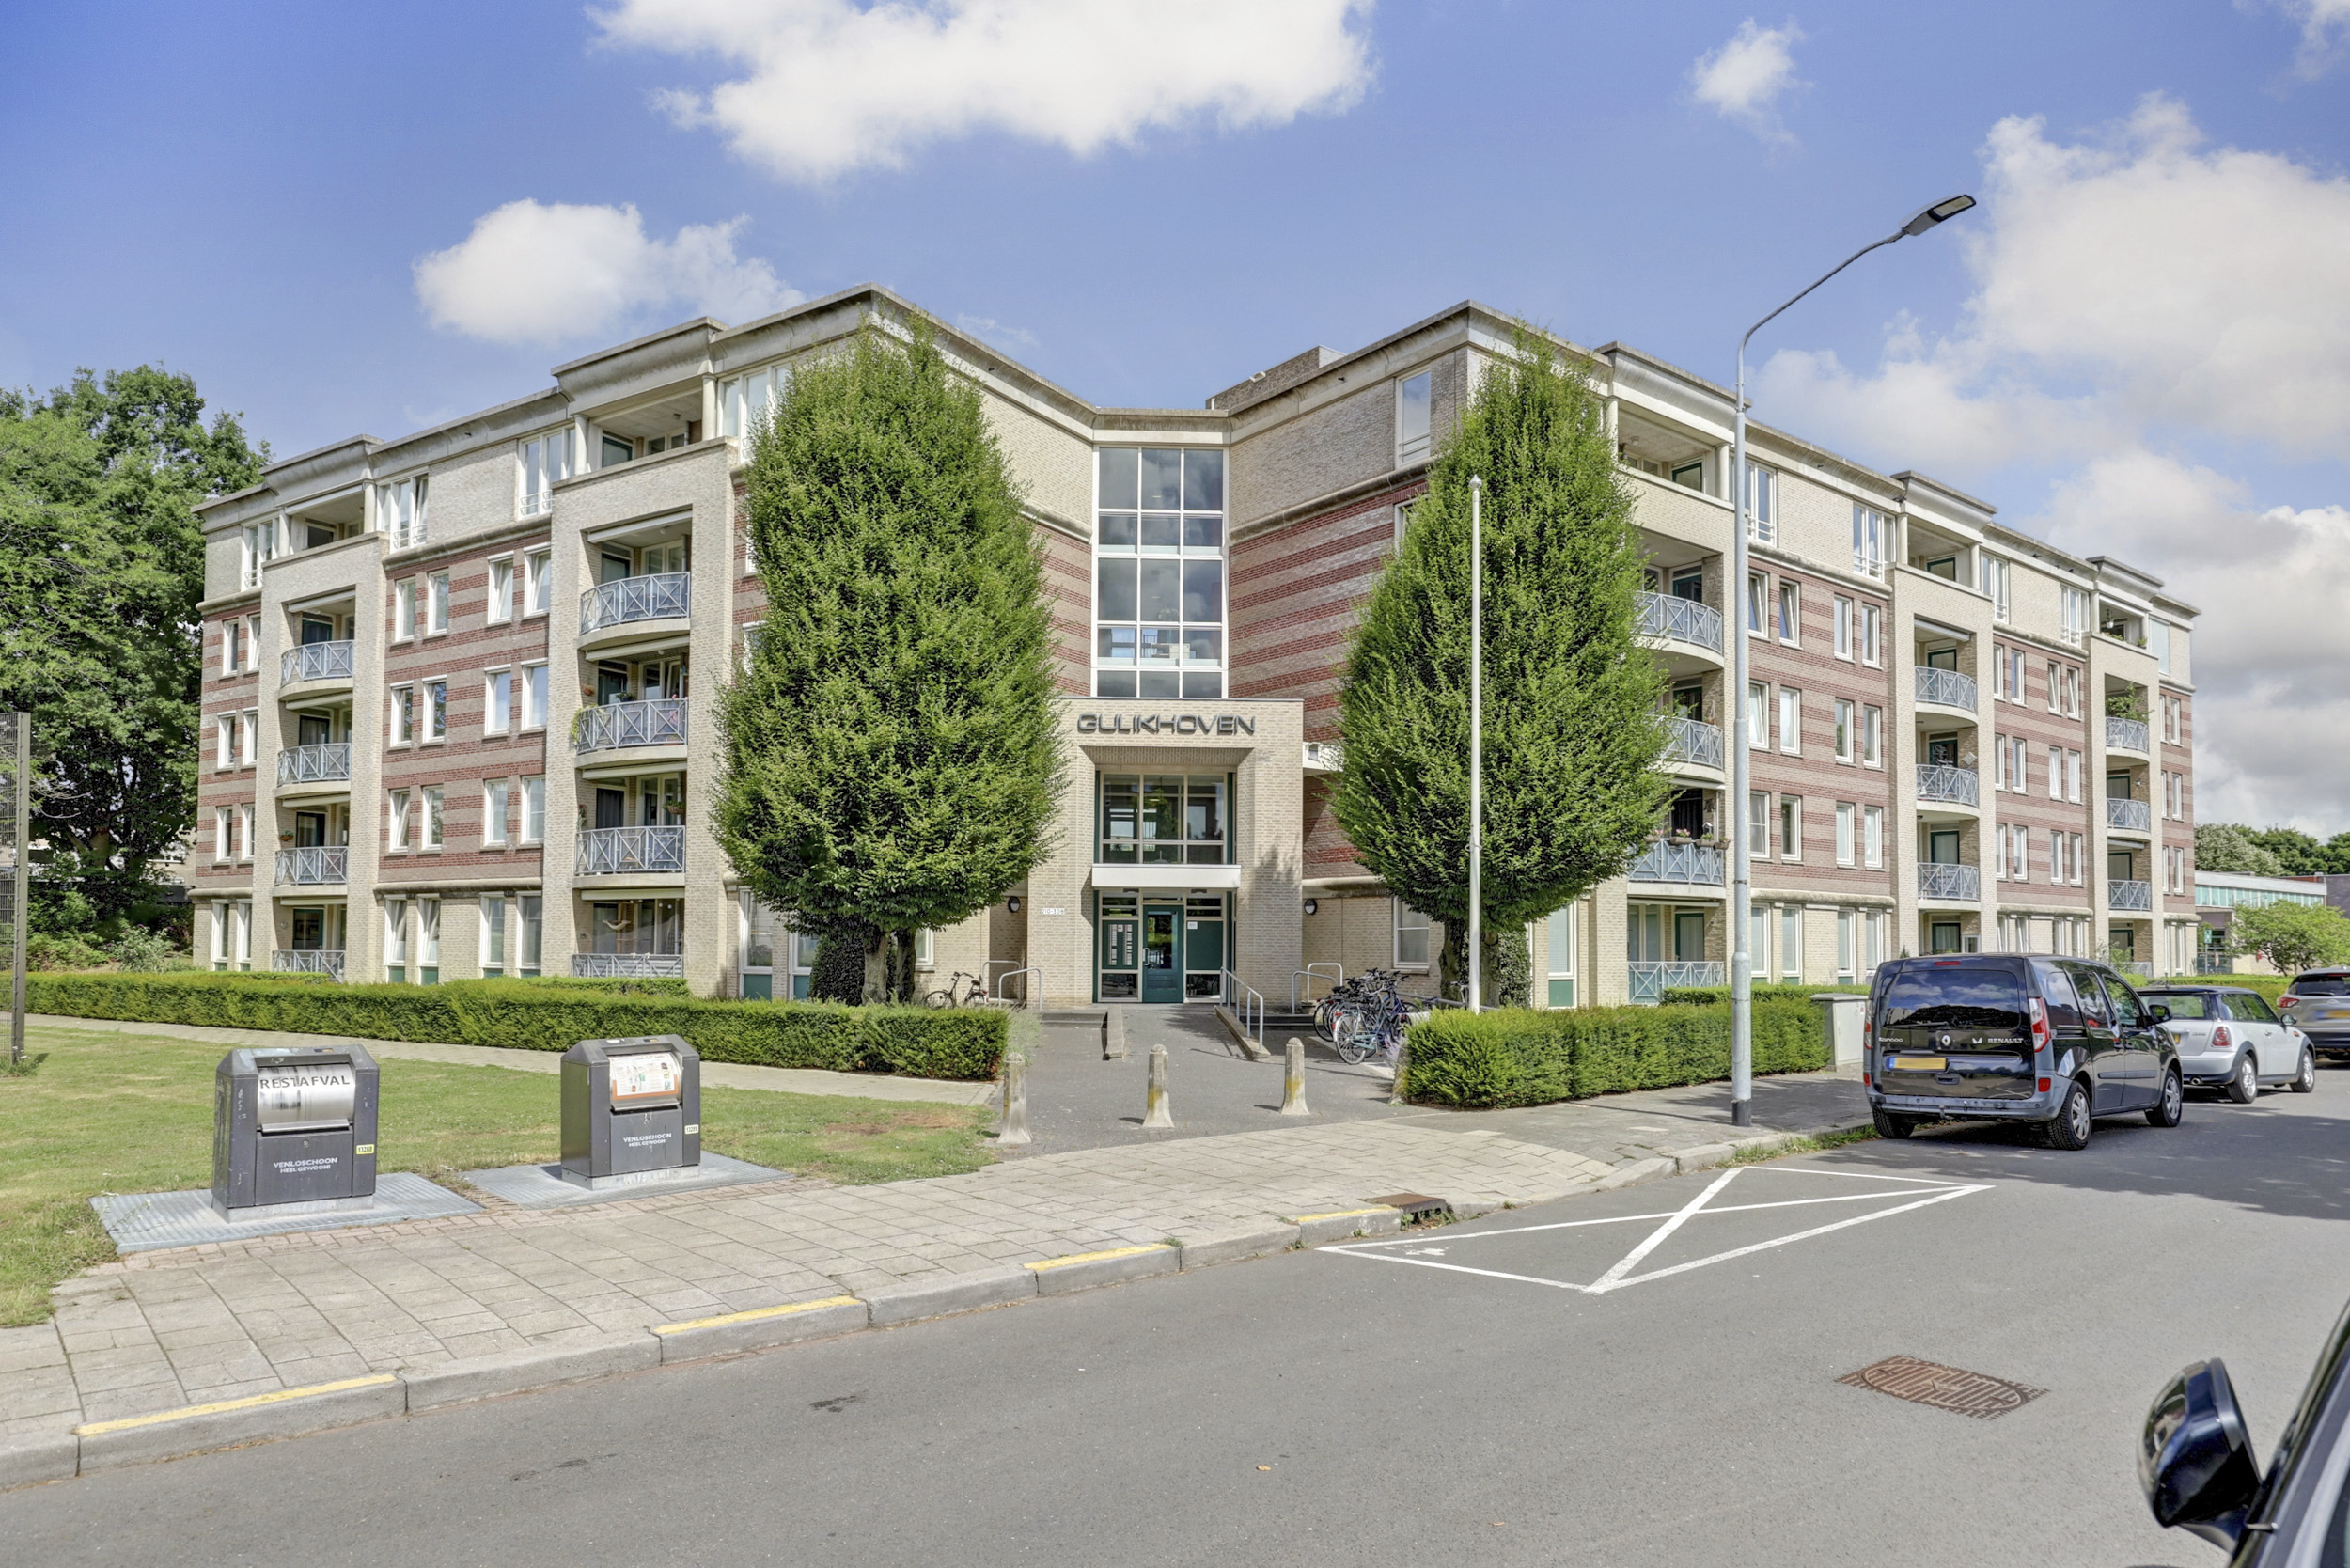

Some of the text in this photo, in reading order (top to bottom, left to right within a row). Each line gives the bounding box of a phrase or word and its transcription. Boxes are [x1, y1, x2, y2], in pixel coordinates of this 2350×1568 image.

[1077, 713, 1256, 736] GULIKHOVEN
[259, 1075, 351, 1089] RESTAFVAL
[274, 1157, 338, 1168] VENLOSCHOON
